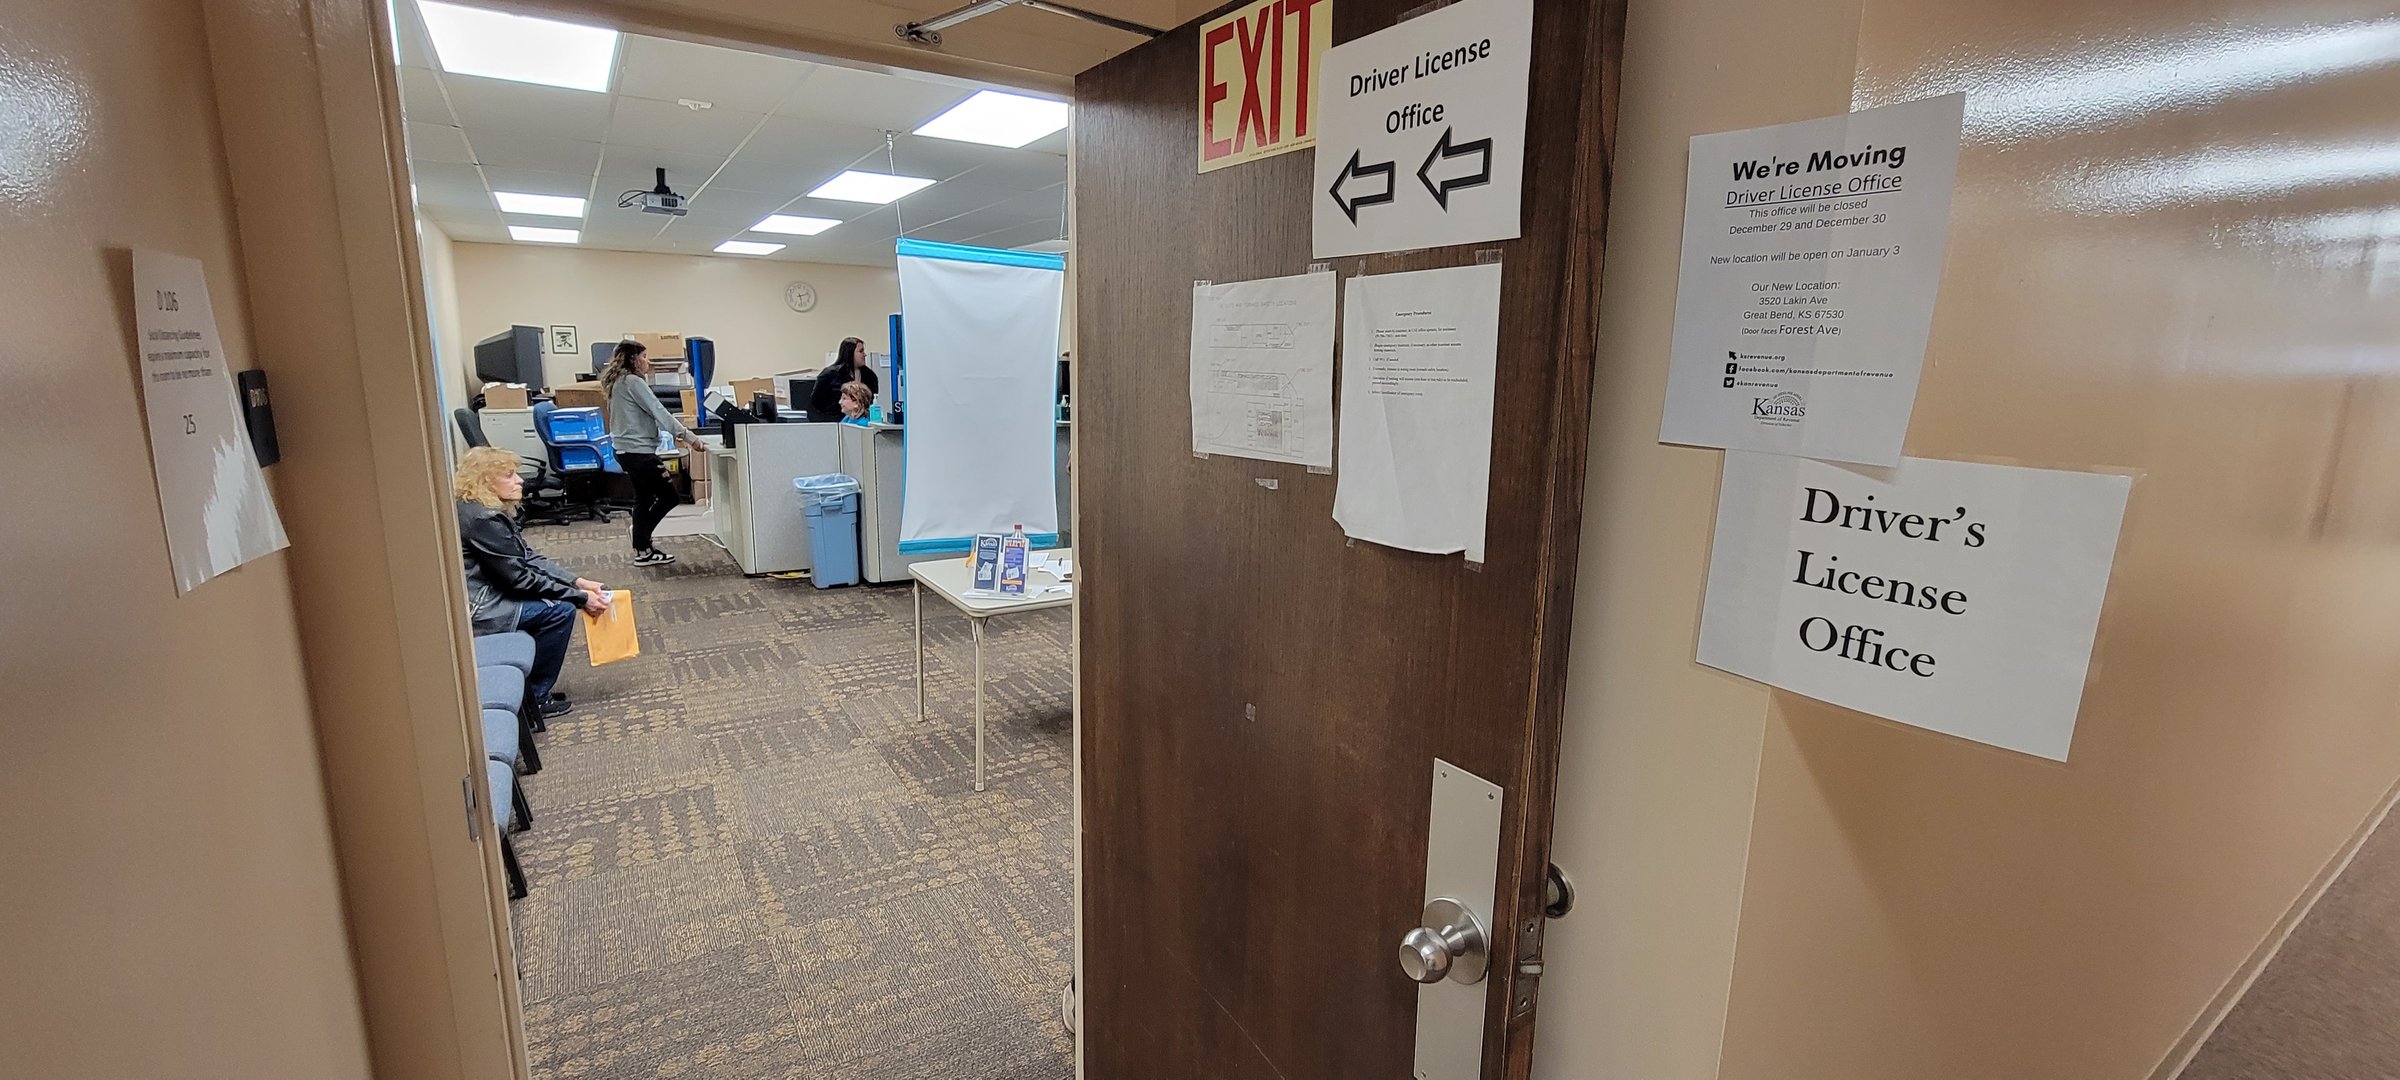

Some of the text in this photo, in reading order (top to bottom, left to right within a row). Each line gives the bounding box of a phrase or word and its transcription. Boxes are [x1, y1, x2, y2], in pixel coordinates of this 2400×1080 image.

[1350, 38, 1491, 98] Driver License
[1203, 0, 1325, 162] EXIT
[1386, 102, 1444, 134] Office
[1733, 144, 1907, 182] We're Moving
[1726, 173, 1902, 206] Driver License Office
[1749, 199, 1868, 219] This office will be closed
[1729, 213, 1886, 235] December 29 and December 30
[1710, 245, 1900, 265] New location will be open on January 3
[1751, 280, 1841, 292] Our New Location:
[1759, 296, 1828, 305] 3520 Lakin Ave
[1743, 310, 1844, 321] Great Bend, KS 67530
[1741, 324, 1842, 336] (Door faces Forest Ave)
[1740, 353, 1786, 362] ksrevenue.org
[1739, 365, 1894, 378] facebook.com/kansasdepartmentofrevenue
[1752, 397, 1806, 417] Kansas
[183, 414, 196, 435] 25
[1799, 486, 1986, 548] Driver’s
[1793, 549, 1968, 616] License
[1799, 616, 1937, 678] Office
